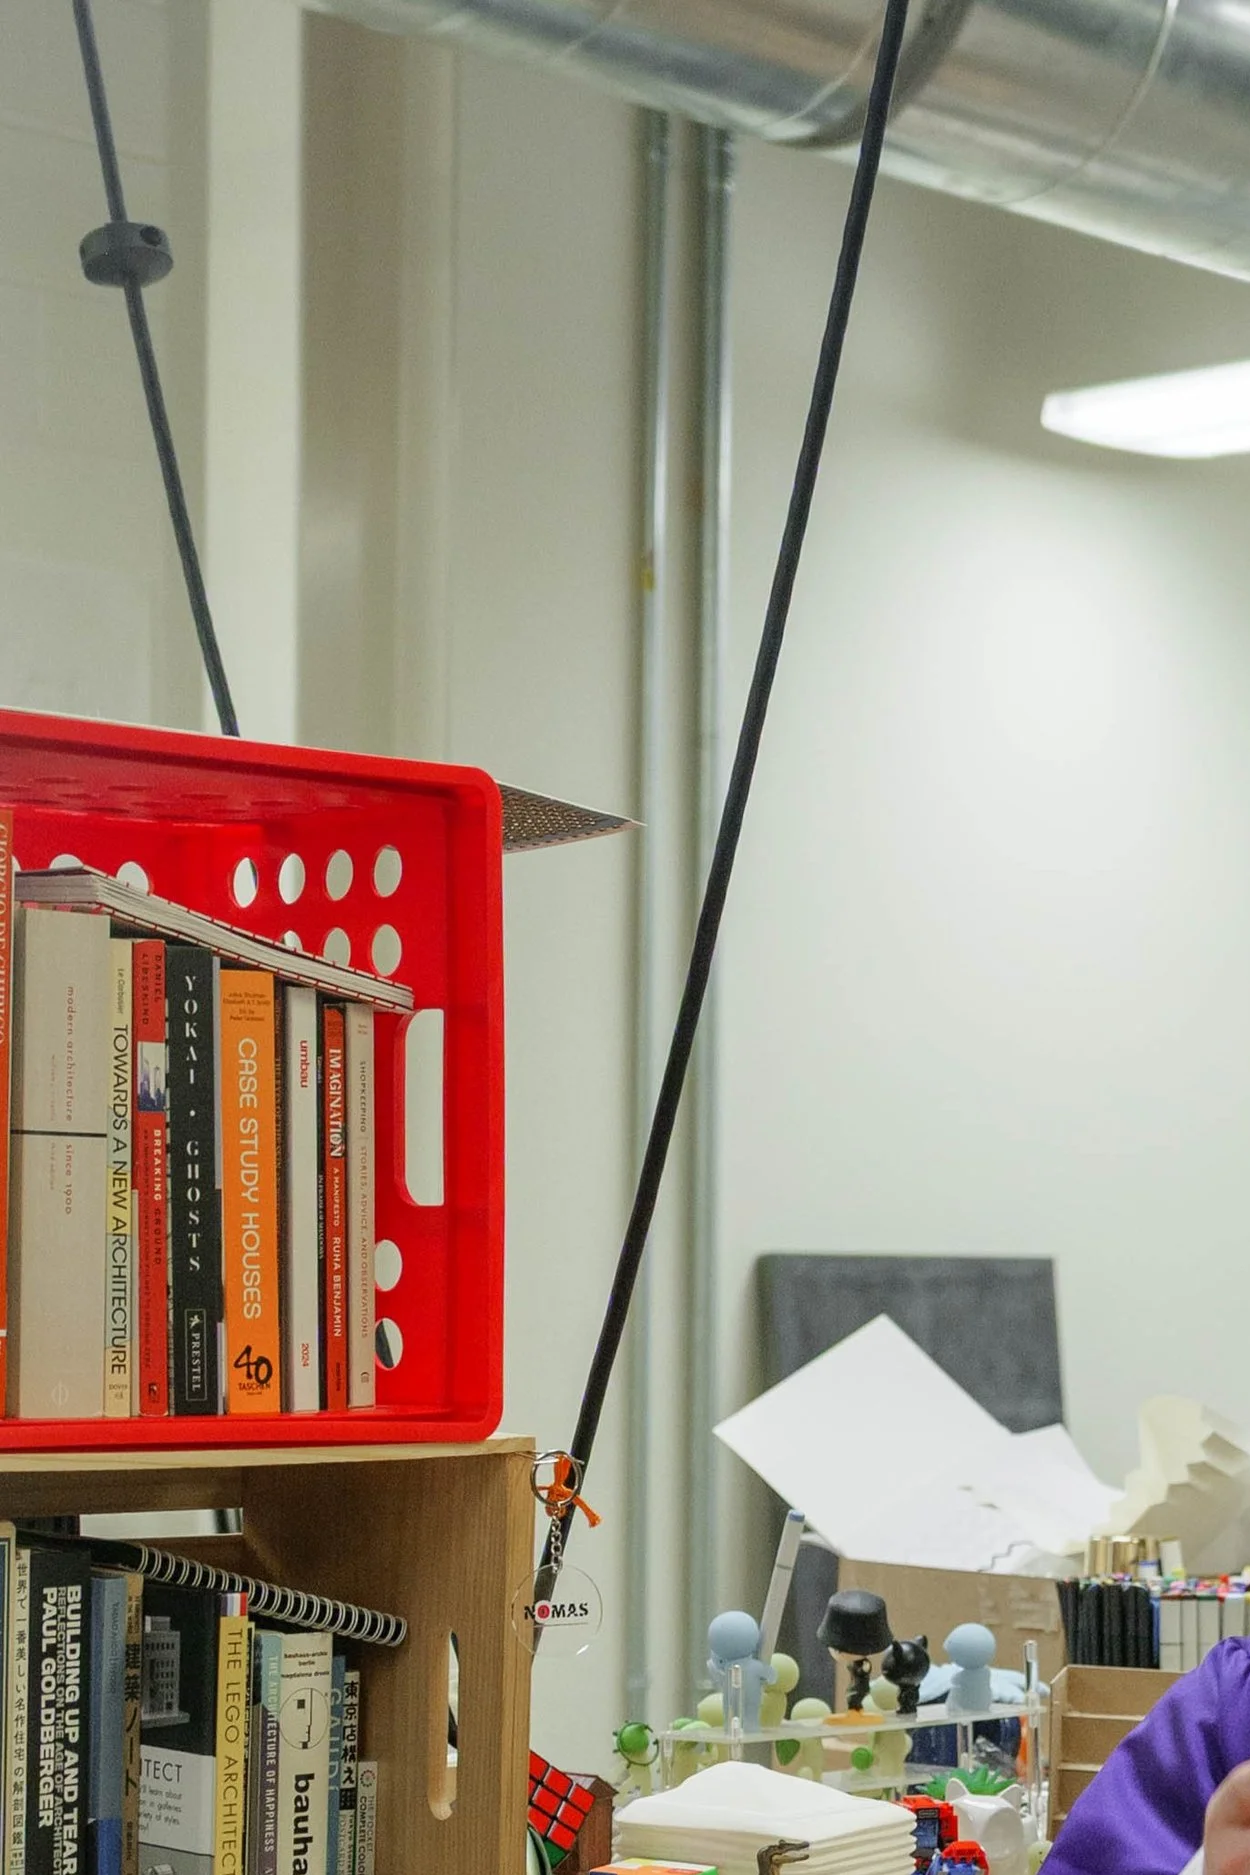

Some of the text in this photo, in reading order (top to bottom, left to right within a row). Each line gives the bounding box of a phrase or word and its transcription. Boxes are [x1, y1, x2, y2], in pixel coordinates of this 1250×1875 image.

[117, 968, 126, 1014] Le Corbusier
[142, 953, 150, 1025] LIBESKIND
[154, 954, 163, 1003] DANIEL
[63, 986, 76, 1215] modern architecture since 1900
[239, 1037, 259, 1110] CASE
[328, 1048, 344, 1157] IMAGINATION
[359, 1060, 367, 1132] SHOPKEEPING
[184, 975, 201, 1271] YOKAI GHOSTS
[240, 1117, 260, 1203] STUDY
[111, 1024, 129, 1374] TOWARDS A NEW ARCHITECTURE
[153, 1129, 163, 1265] BREAKING GROUND
[299, 1039, 311, 1367] umbau 2024
[333, 1176, 341, 1226] MANIFESTO
[241, 1212, 262, 1320] HOUSES
[332, 1237, 342, 1269] RUHA
[360, 1236, 369, 1259] AND
[332, 1274, 342, 1337] BENJAMIN
[360, 1262, 369, 1338] OBSERVATIONS
[191, 1332, 201, 1391] PRESTEL
[233, 1344, 273, 1384] 40
[55, 1587, 66, 1682] REFLECTIONS
[524, 1602, 588, 1620] NOMAS
[64, 1585, 82, 1703] BUILDING
[226, 1629, 243, 1669] THE
[268, 1656, 279, 1672] THE
[38, 1586, 57, 1829] PAUL GOLDBERGER
[54, 1711, 64, 1738] THE
[55, 1686, 65, 1708] ON
[64, 1708, 80, 1743] UP
[225, 1682, 242, 1743] LEGO
[266, 1682, 278, 1766] ARCHITECTURE
[54, 1742, 64, 1770] AGE
[340, 1681, 359, 1784] 東京店構え
[53, 1776, 63, 1794] OF
[63, 1750, 79, 1803] AND
[265, 1770, 276, 1783] OF
[264, 1788, 276, 1852] HAPPINESS
[358, 1796, 367, 1843] COMPLETE
[366, 1795, 374, 1852] THE POCKET
